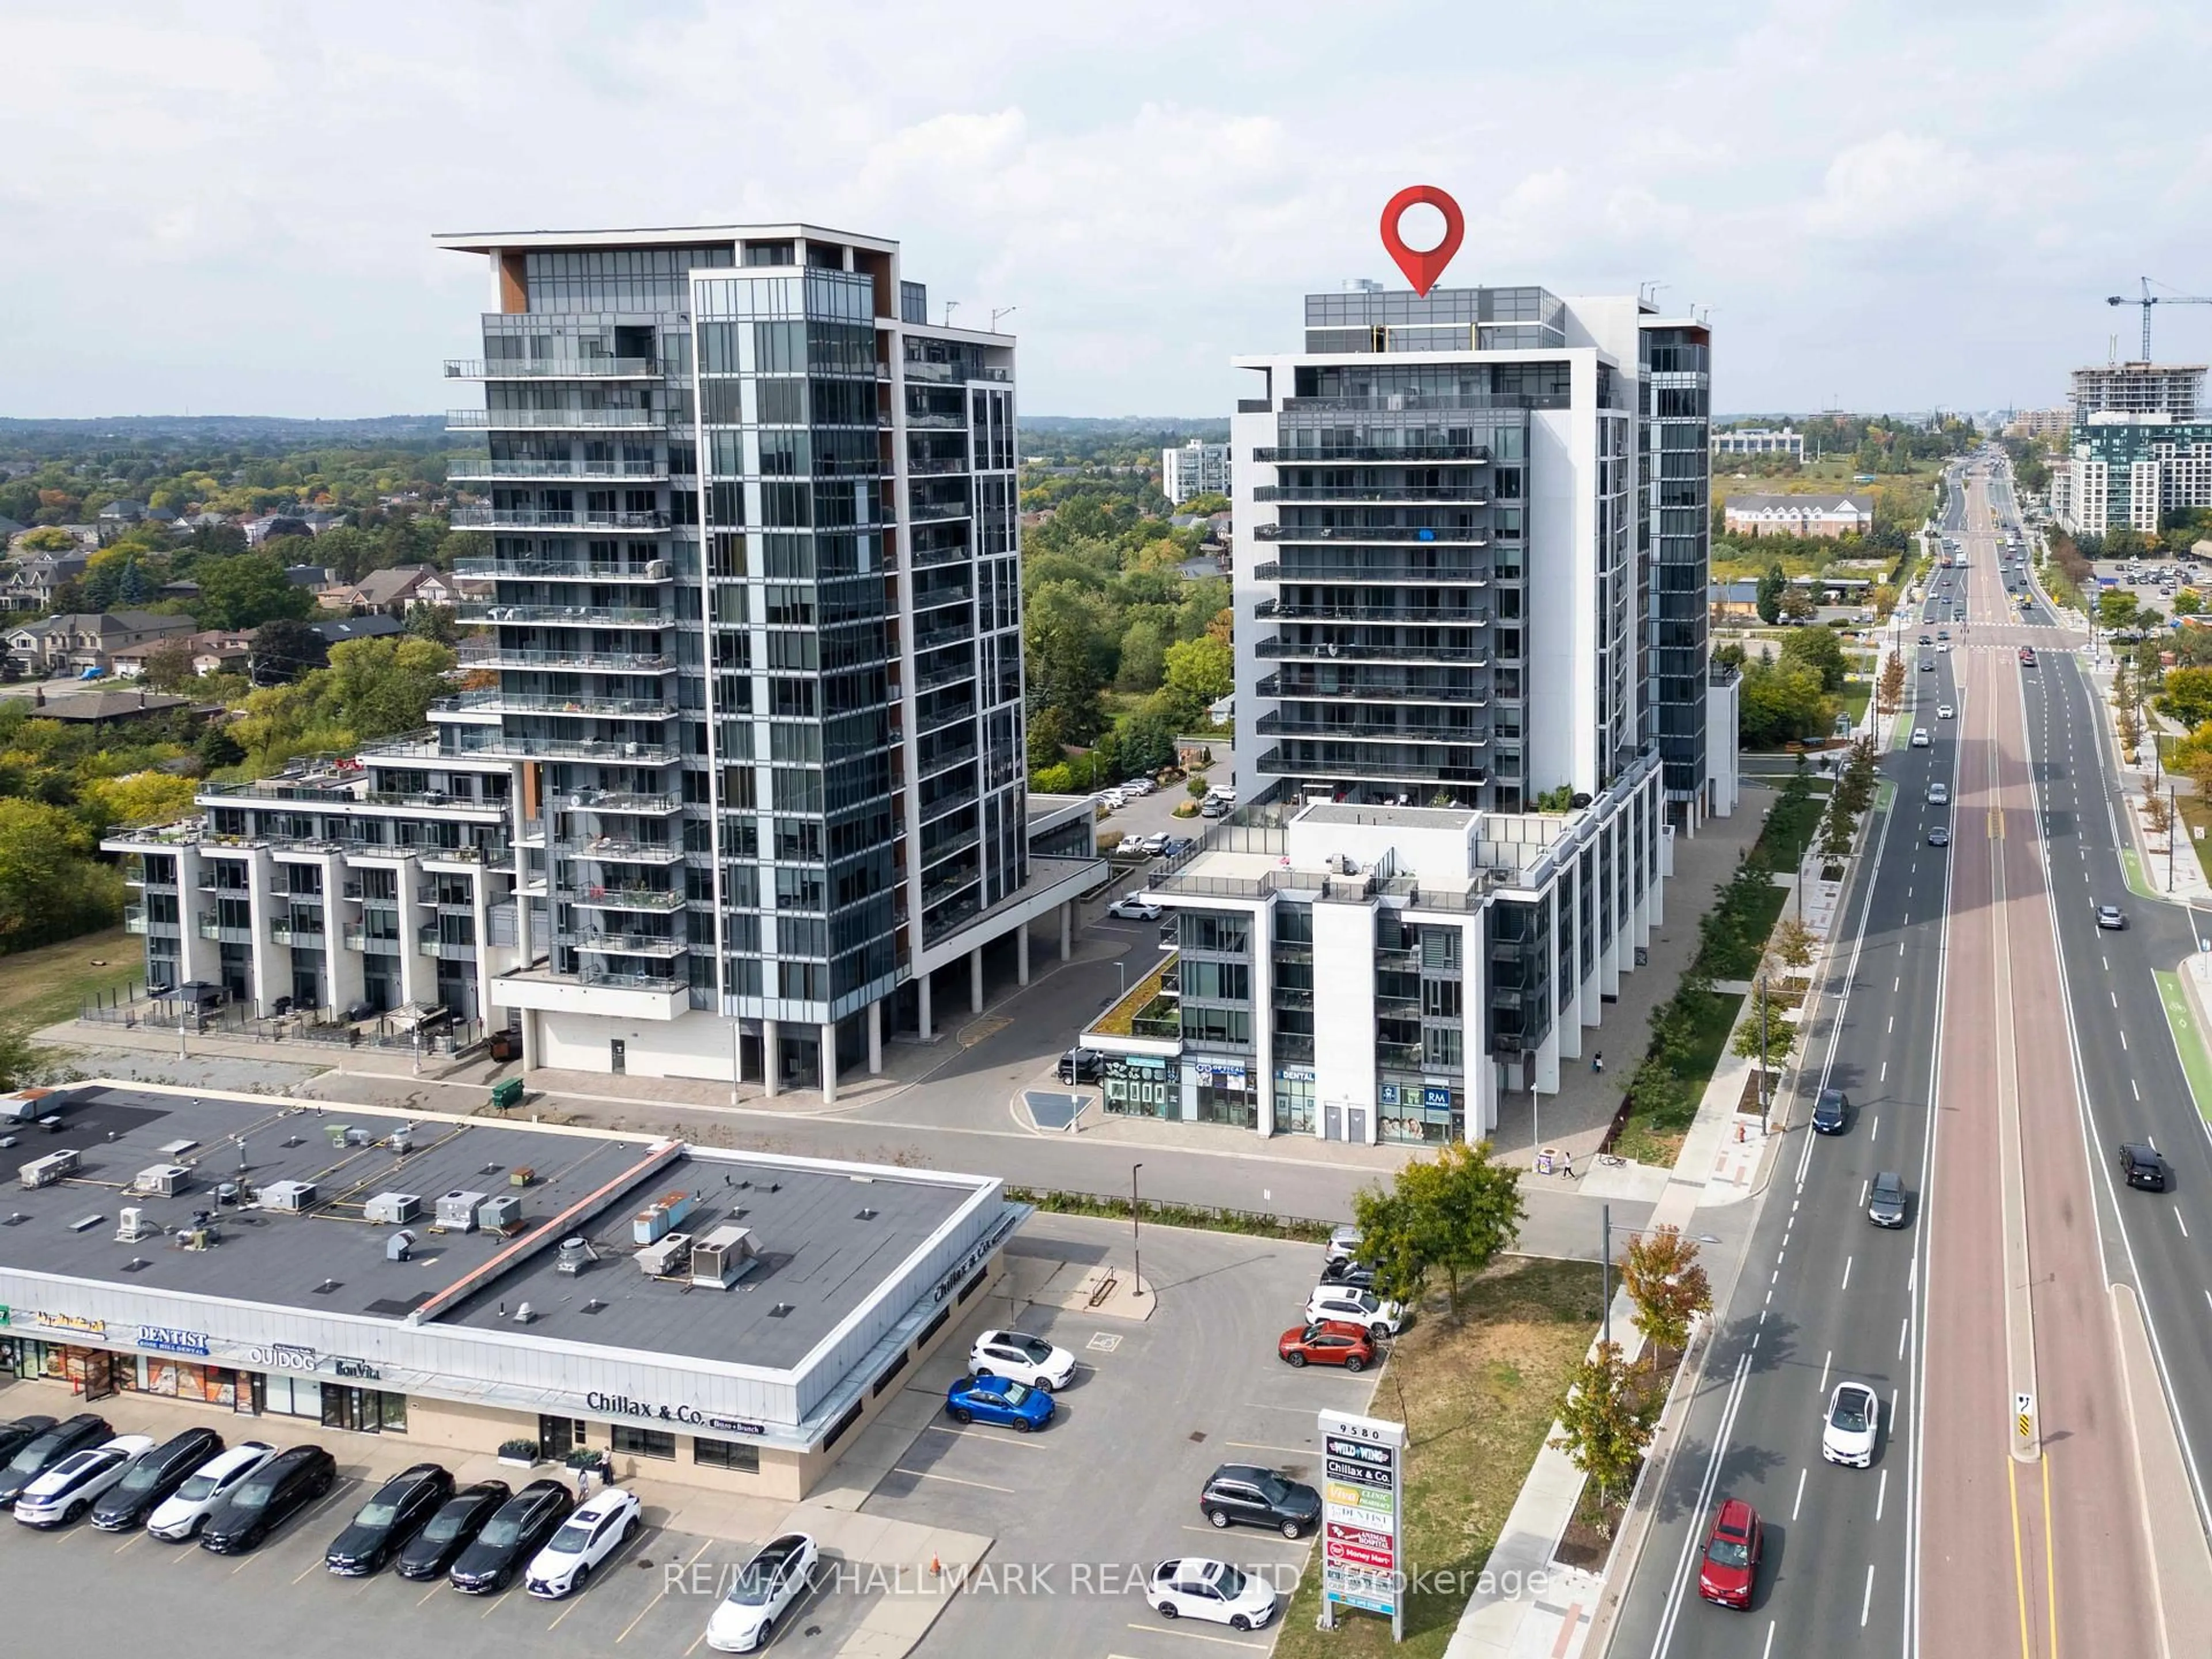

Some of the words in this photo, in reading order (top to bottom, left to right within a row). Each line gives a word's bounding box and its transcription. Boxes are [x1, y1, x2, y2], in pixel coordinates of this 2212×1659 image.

[1283, 1070, 1315, 1081] DENTAL
[1429, 1092, 1445, 1103] RM
[138, 1325, 207, 1348] DENTIST
[587, 1391, 652, 1417] Chillax
[659, 1405, 672, 1420] &
[1334, 1442, 1356, 1456] WILD
[1359, 1447, 1384, 1463] WING
[1328, 1461, 1362, 1476] Chillax
[1365, 1471, 1373, 1479] &
[1375, 1471, 1390, 1483] Co.
[1362, 1490, 1388, 1501] CLINIC
[1346, 1548, 1370, 1561] Money
[1371, 1554, 1390, 1564] Mart
